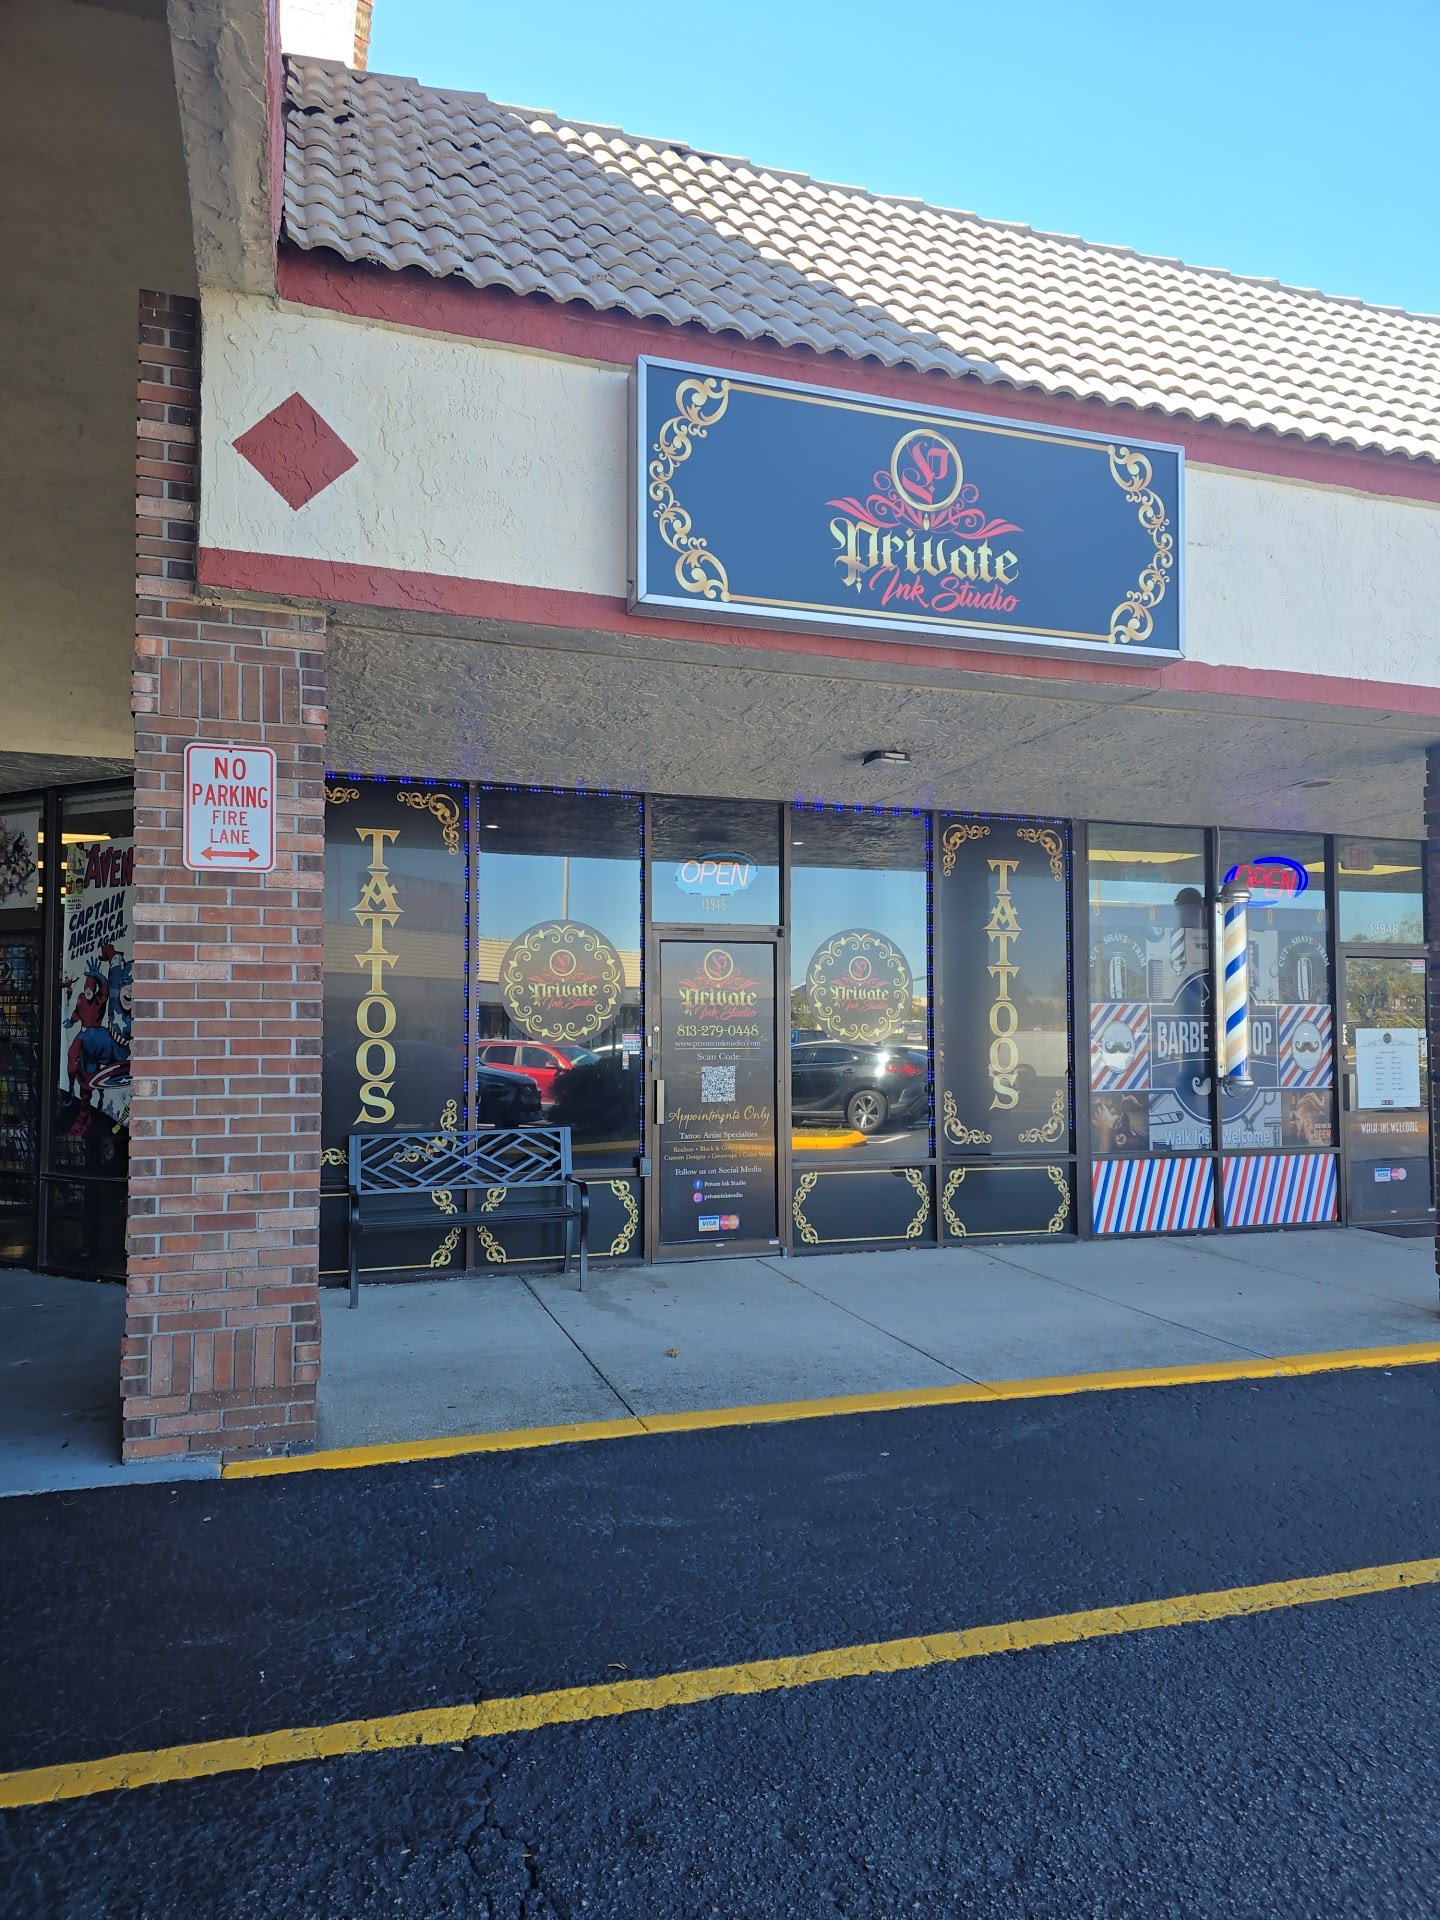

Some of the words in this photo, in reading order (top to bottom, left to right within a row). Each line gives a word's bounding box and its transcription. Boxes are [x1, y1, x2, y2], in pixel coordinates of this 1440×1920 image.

[829, 517, 1020, 595] Private
[868, 566, 930, 608] Ink
[931, 576, 1020, 612] Studio
[214, 757, 247, 780] NO
[192, 783, 268, 809] PARKING
[212, 810, 248, 826] FIRE
[210, 829, 250, 844] LANE
[681, 860, 749, 886] OPEN
[1236, 865, 1297, 899] OPEN
[69, 890, 125, 932] CAPTAIN
[702, 899, 726, 910] 13946
[68, 910, 124, 951] AMERICA
[1368, 924, 1399, 935] 13948
[71, 942, 95, 960] LIVES
[97, 925, 128, 949] AGAIN!
[1103, 934, 1129, 945] SHAVE
[1131, 942, 1147, 967] TRIM
[1278, 946, 1288, 967] CUT
[1291, 935, 1314, 947] SHAVE
[1316, 943, 1330, 967] TRIM
[349, 827, 405, 1126] TATTOOS
[982, 859, 1023, 1111] TATTOOS
[528, 982, 598, 1007] Private
[542, 996, 564, 1010] Ink
[565, 996, 598, 1010] Studio
[679, 987, 758, 1017] Private
[829, 985, 890, 1008] Private
[695, 1004, 720, 1021] Ink
[720, 1005, 757, 1021] Studio
[677, 1023, 759, 1037] 813-279-0448
[1157, 1021, 1210, 1058] BARBE
[697, 1053, 717, 1061] Scan
[719, 1053, 740, 1061] Code
[668, 1107, 740, 1129] Appointments
[744, 1105, 770, 1128] Only
[1360, 1122, 1389, 1134] WALK-INS
[1391, 1121, 1418, 1133] WELCOME
[679, 1132, 701, 1140] Tattoo
[723, 1130, 758, 1139] Specialties
[1164, 1129, 1191, 1145] Walk
[1194, 1129, 1210, 1144] Ins
[1222, 1128, 1270, 1144] Welcome
[1313, 1129, 1332, 1140] OPEN
[686, 1153, 706, 1161] Designs
[743, 1150, 757, 1158] Color
[758, 1149, 773, 1157] Work
[675, 1168, 697, 1176] Follow
[718, 1166, 739, 1174] Social
[740, 1165, 762, 1173] Media
